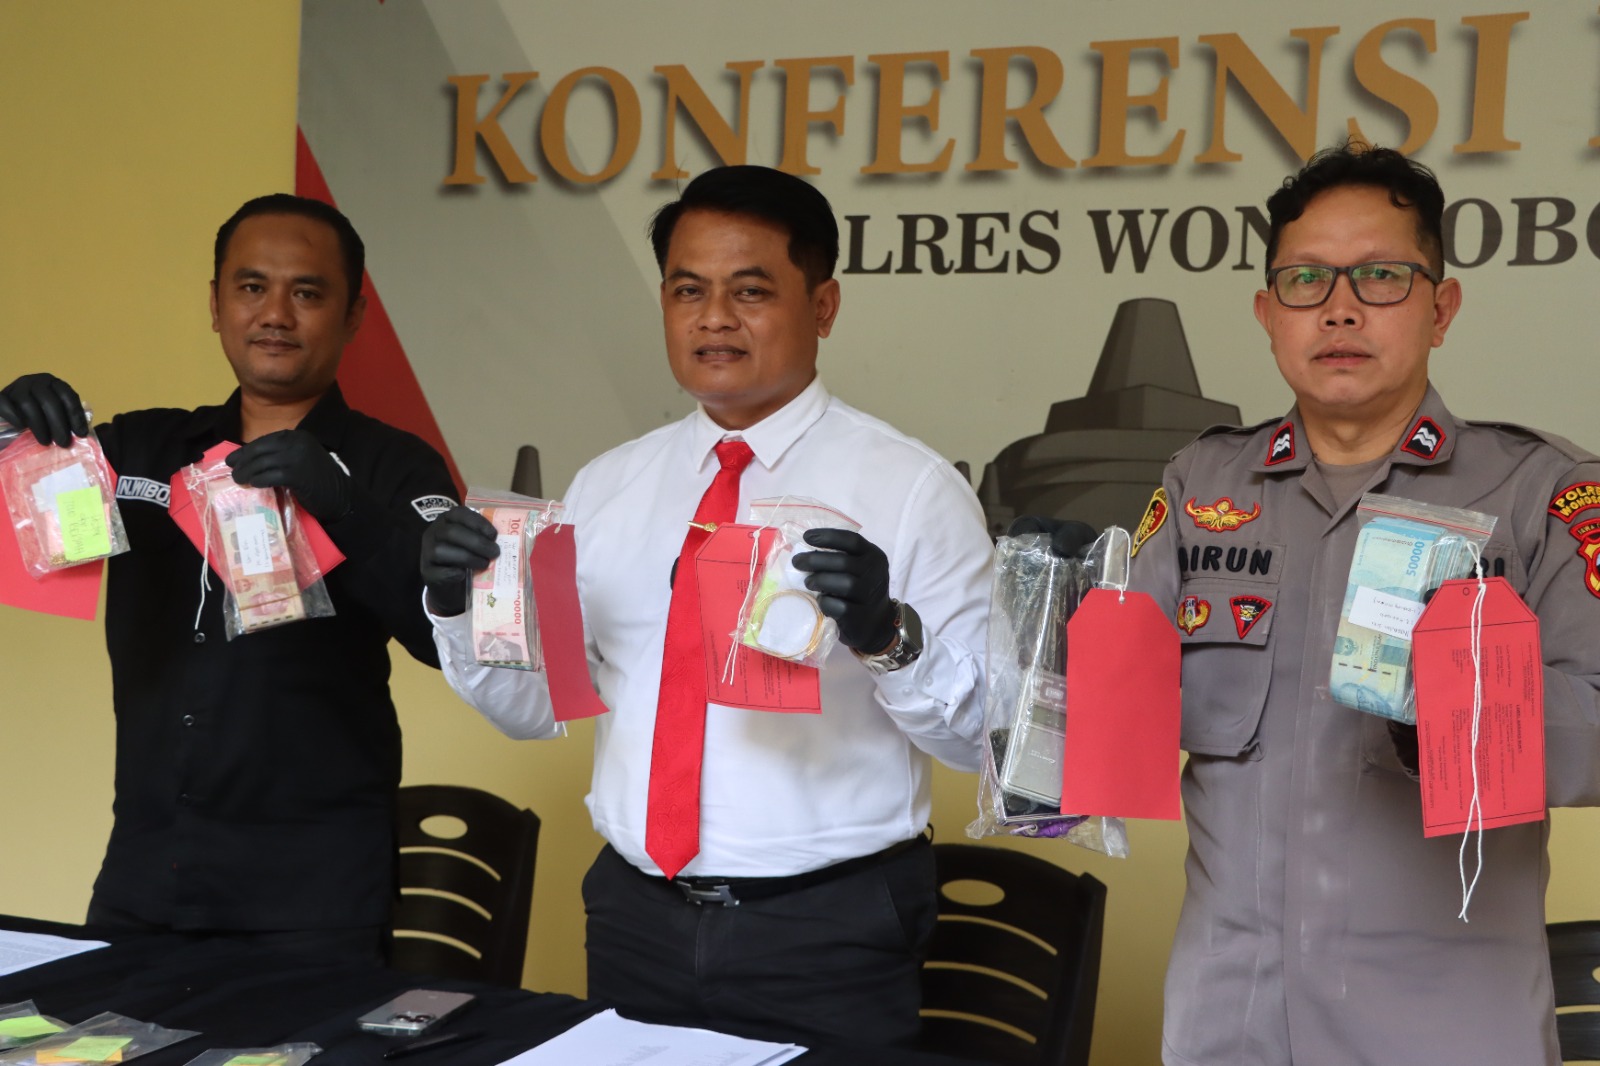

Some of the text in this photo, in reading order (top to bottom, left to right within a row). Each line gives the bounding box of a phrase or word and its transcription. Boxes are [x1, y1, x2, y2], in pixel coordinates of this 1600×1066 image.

[444, 11, 1530, 186] KONFERENSI
[842, 210, 1061, 275] LRES
[119, 479, 170, 504] N.WIBO
[1406, 541, 1425, 576] 50000
